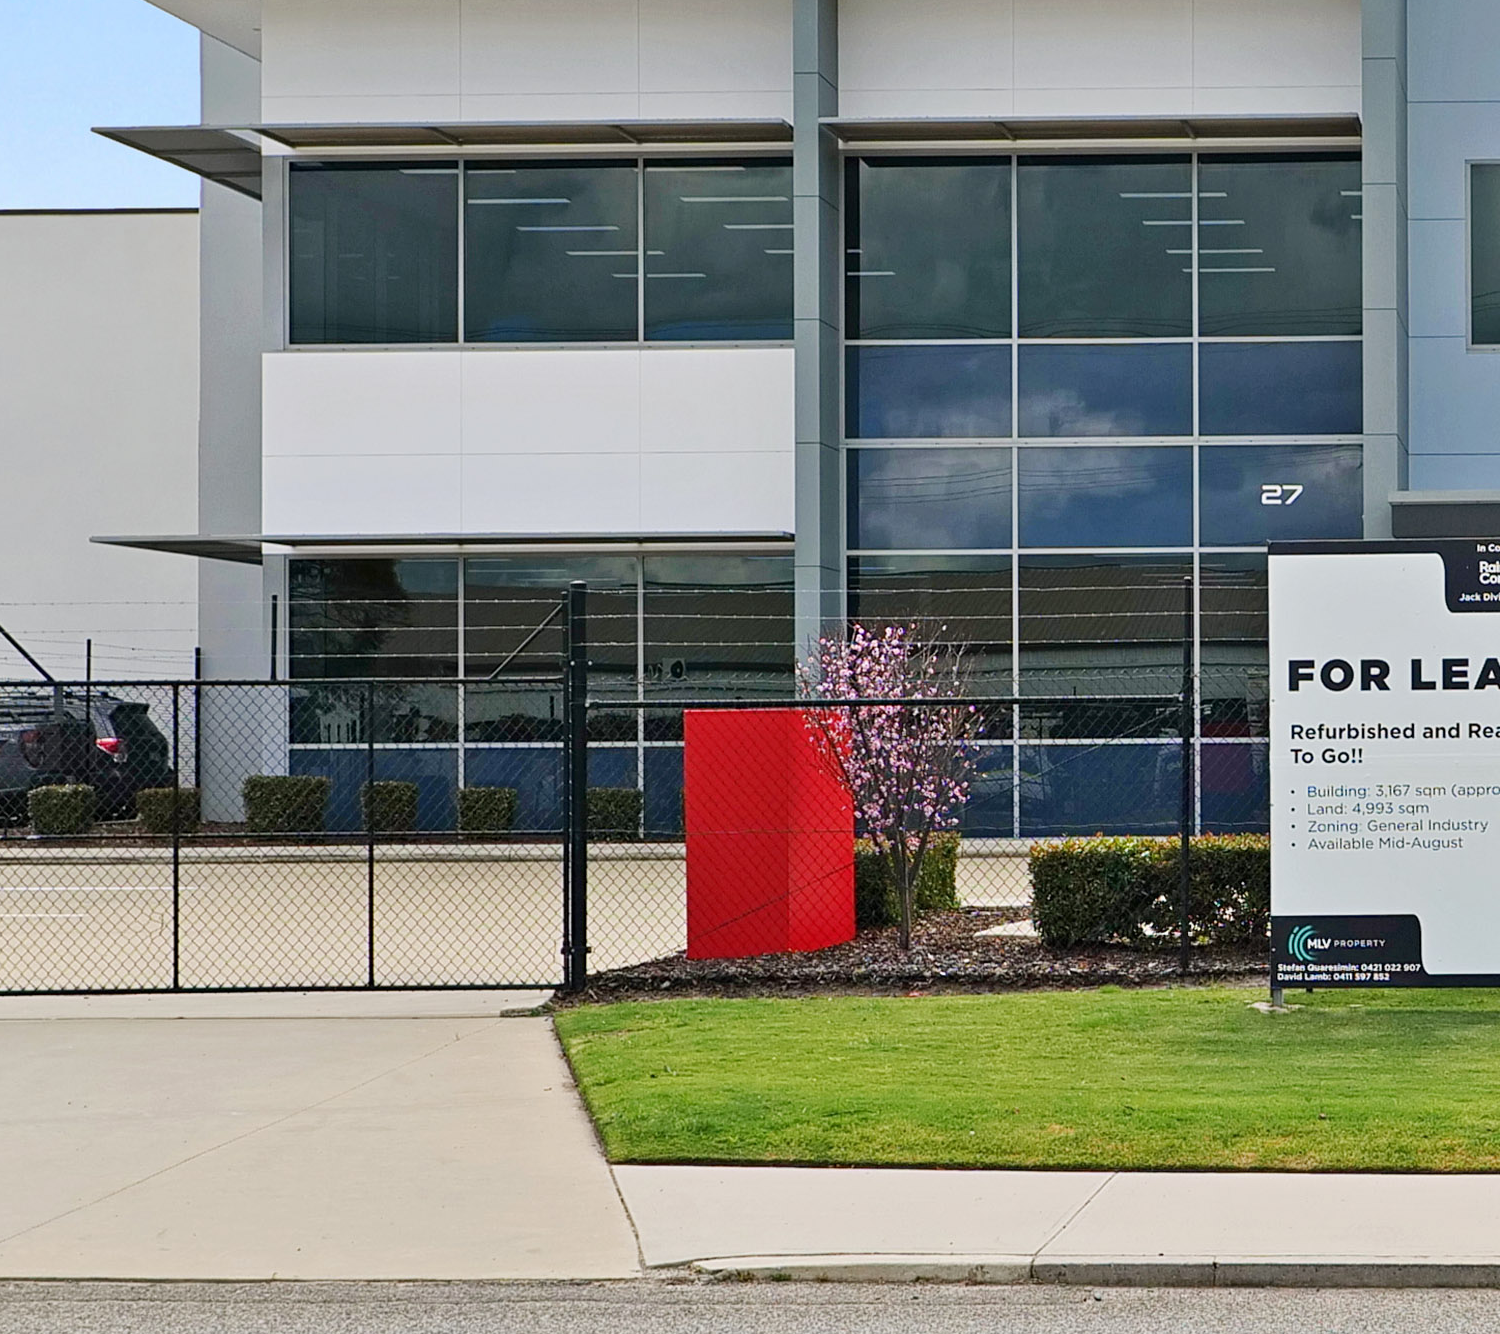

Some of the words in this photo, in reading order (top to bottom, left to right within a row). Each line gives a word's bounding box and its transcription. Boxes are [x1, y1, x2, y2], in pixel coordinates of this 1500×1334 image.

[1261, 484, 1304, 505] 27
[1476, 543, 1487, 552] In
[1459, 593, 1481, 602] Jack
[1288, 659, 1391, 691] FOR
[1291, 723, 1415, 740] Refurbished
[1422, 722, 1460, 739] and
[1290, 748, 1314, 764] To
[1321, 747, 1363, 764] Go!!
[1307, 785, 1370, 799] Building:
[1375, 784, 1410, 798] 3,167
[1415, 787, 1446, 799] sqm
[1307, 803, 1348, 815] Land:
[1352, 802, 1393, 816] 4,993
[1398, 804, 1429, 816] sqm
[1308, 821, 1362, 834] Zoning:
[1367, 819, 1423, 832] General
[1428, 819, 1488, 834] Industry
[1308, 837, 1374, 850] Available
[1378, 836, 1463, 851] Mid-August
[1306, 938, 1332, 949] MLV
[1334, 939, 1386, 948] PROPERTY
[1277, 963, 1305, 972] Stefan
[1361, 963, 1382, 971] 0421
[1384, 963, 1402, 971] 022
[1403, 963, 1421, 972] 907
[1277, 972, 1302, 981] David
[1304, 972, 1332, 981] Lamb:
[1333, 972, 1353, 980] 0411
